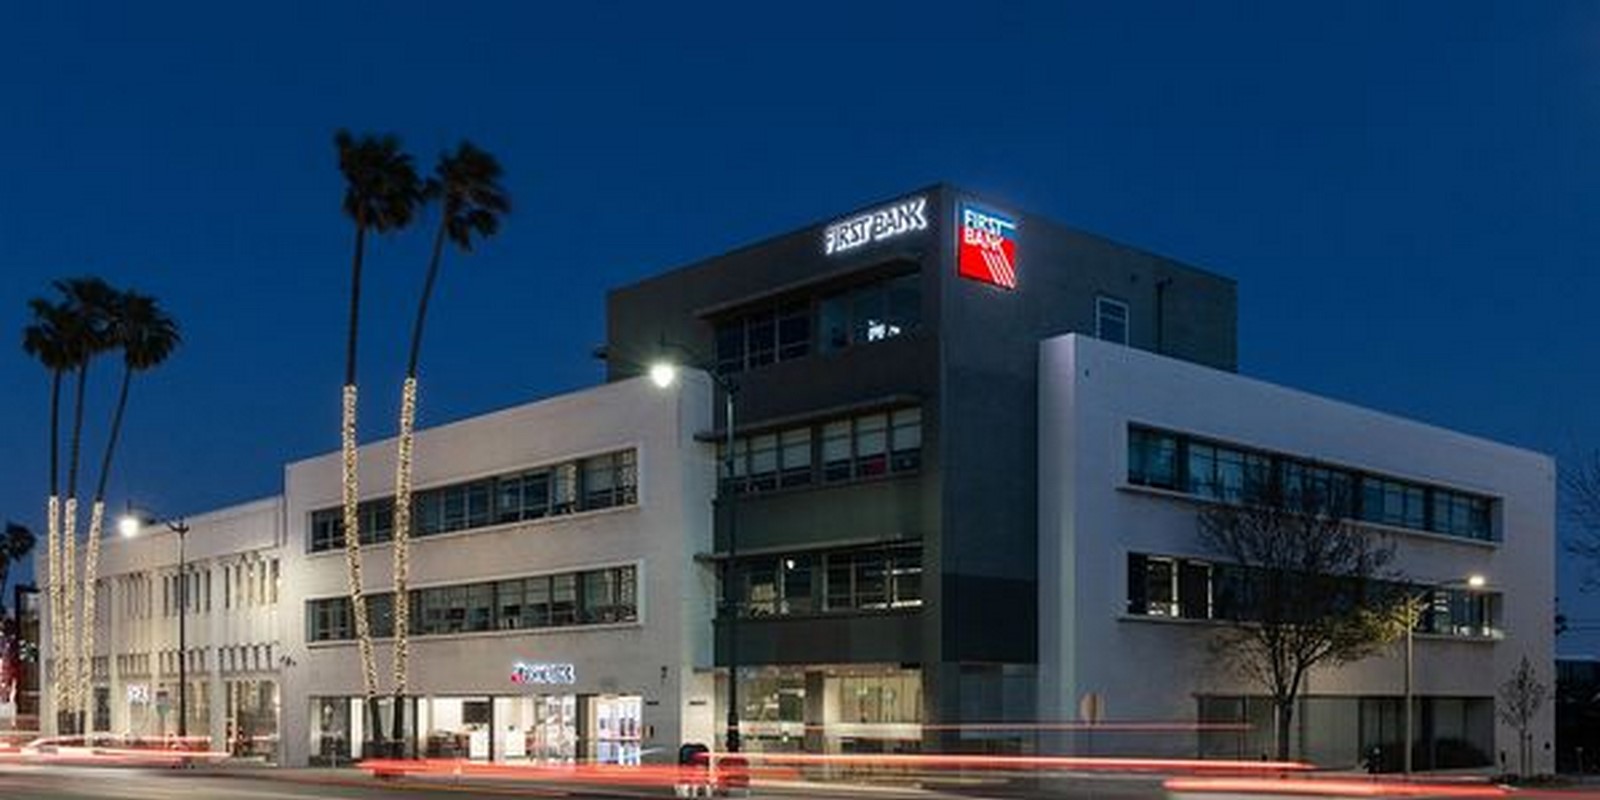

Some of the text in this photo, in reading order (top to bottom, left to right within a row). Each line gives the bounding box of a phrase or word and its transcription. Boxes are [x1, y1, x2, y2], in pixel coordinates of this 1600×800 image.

[825, 199, 928, 255] FIRST BANK
[964, 209, 1012, 235] FIRST
[964, 228, 1004, 251] BANK
